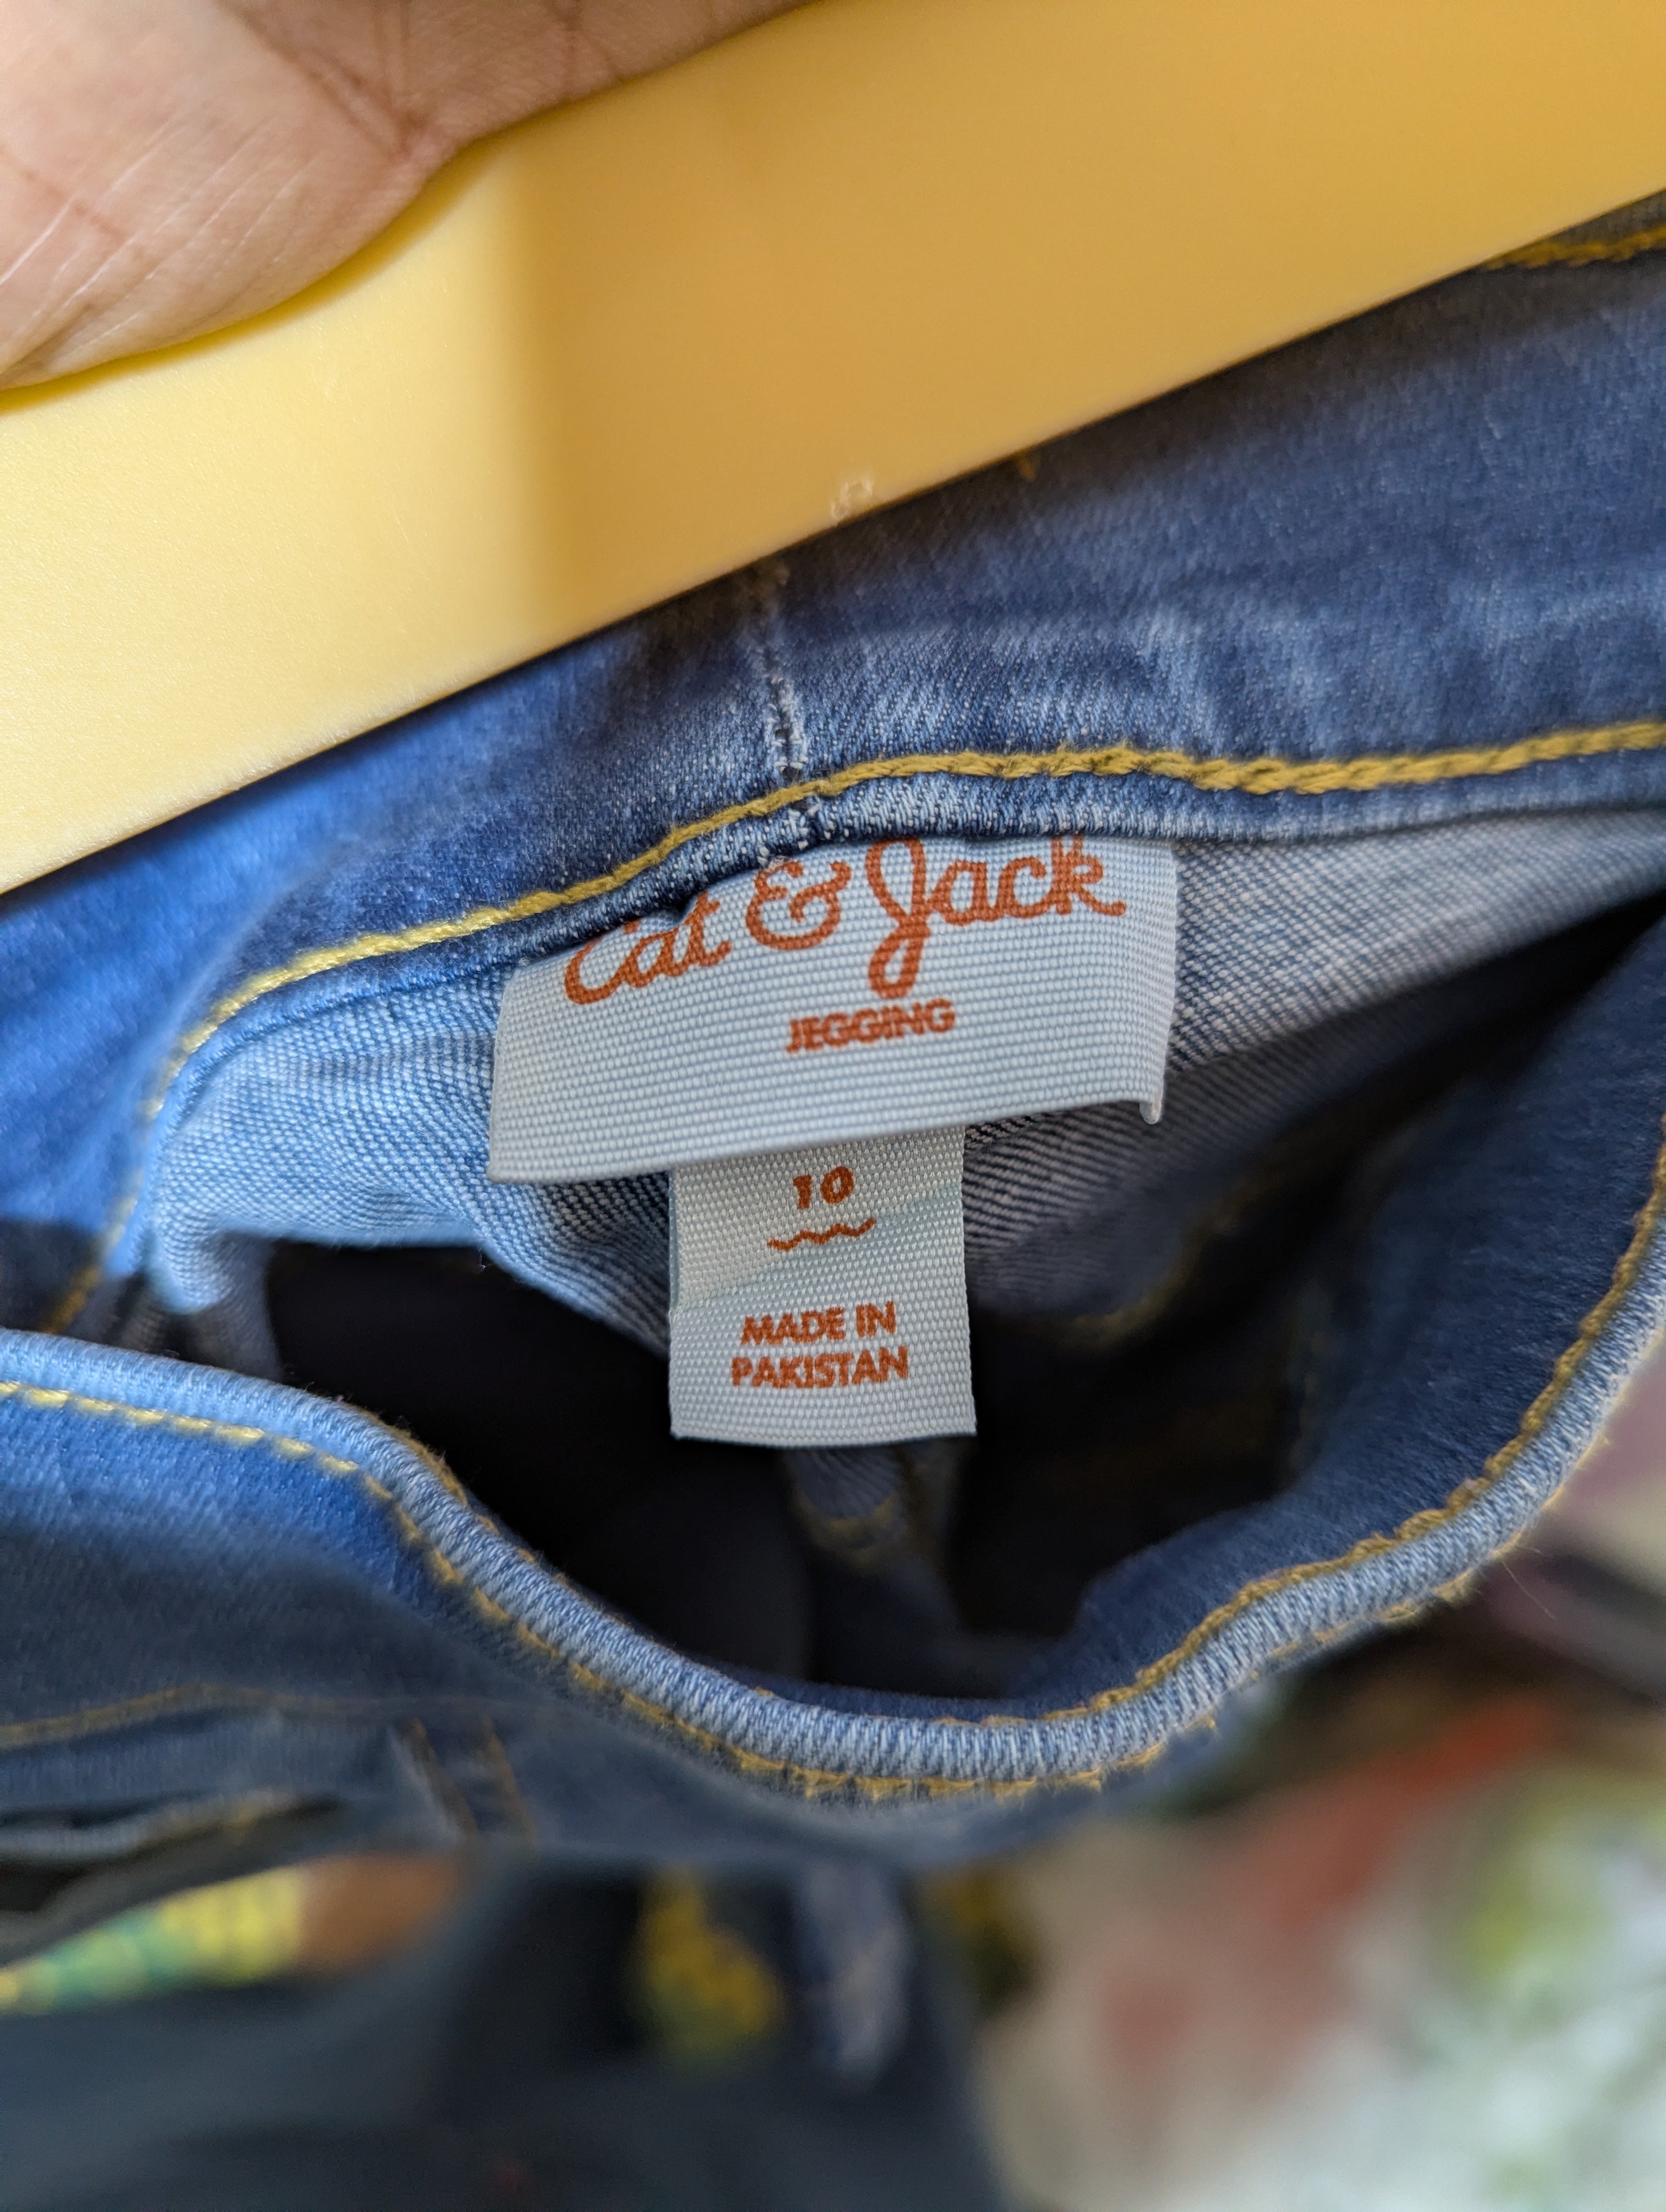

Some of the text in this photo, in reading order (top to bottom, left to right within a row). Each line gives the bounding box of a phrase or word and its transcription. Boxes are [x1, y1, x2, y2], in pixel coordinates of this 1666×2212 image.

[564, 835, 1127, 1005] Cat & Jack
[786, 998, 956, 1053] JEGGING
[793, 1166, 855, 1210] 10
[741, 1301, 896, 1345] MADE IN
[731, 1346, 909, 1389] PAKISTAN
